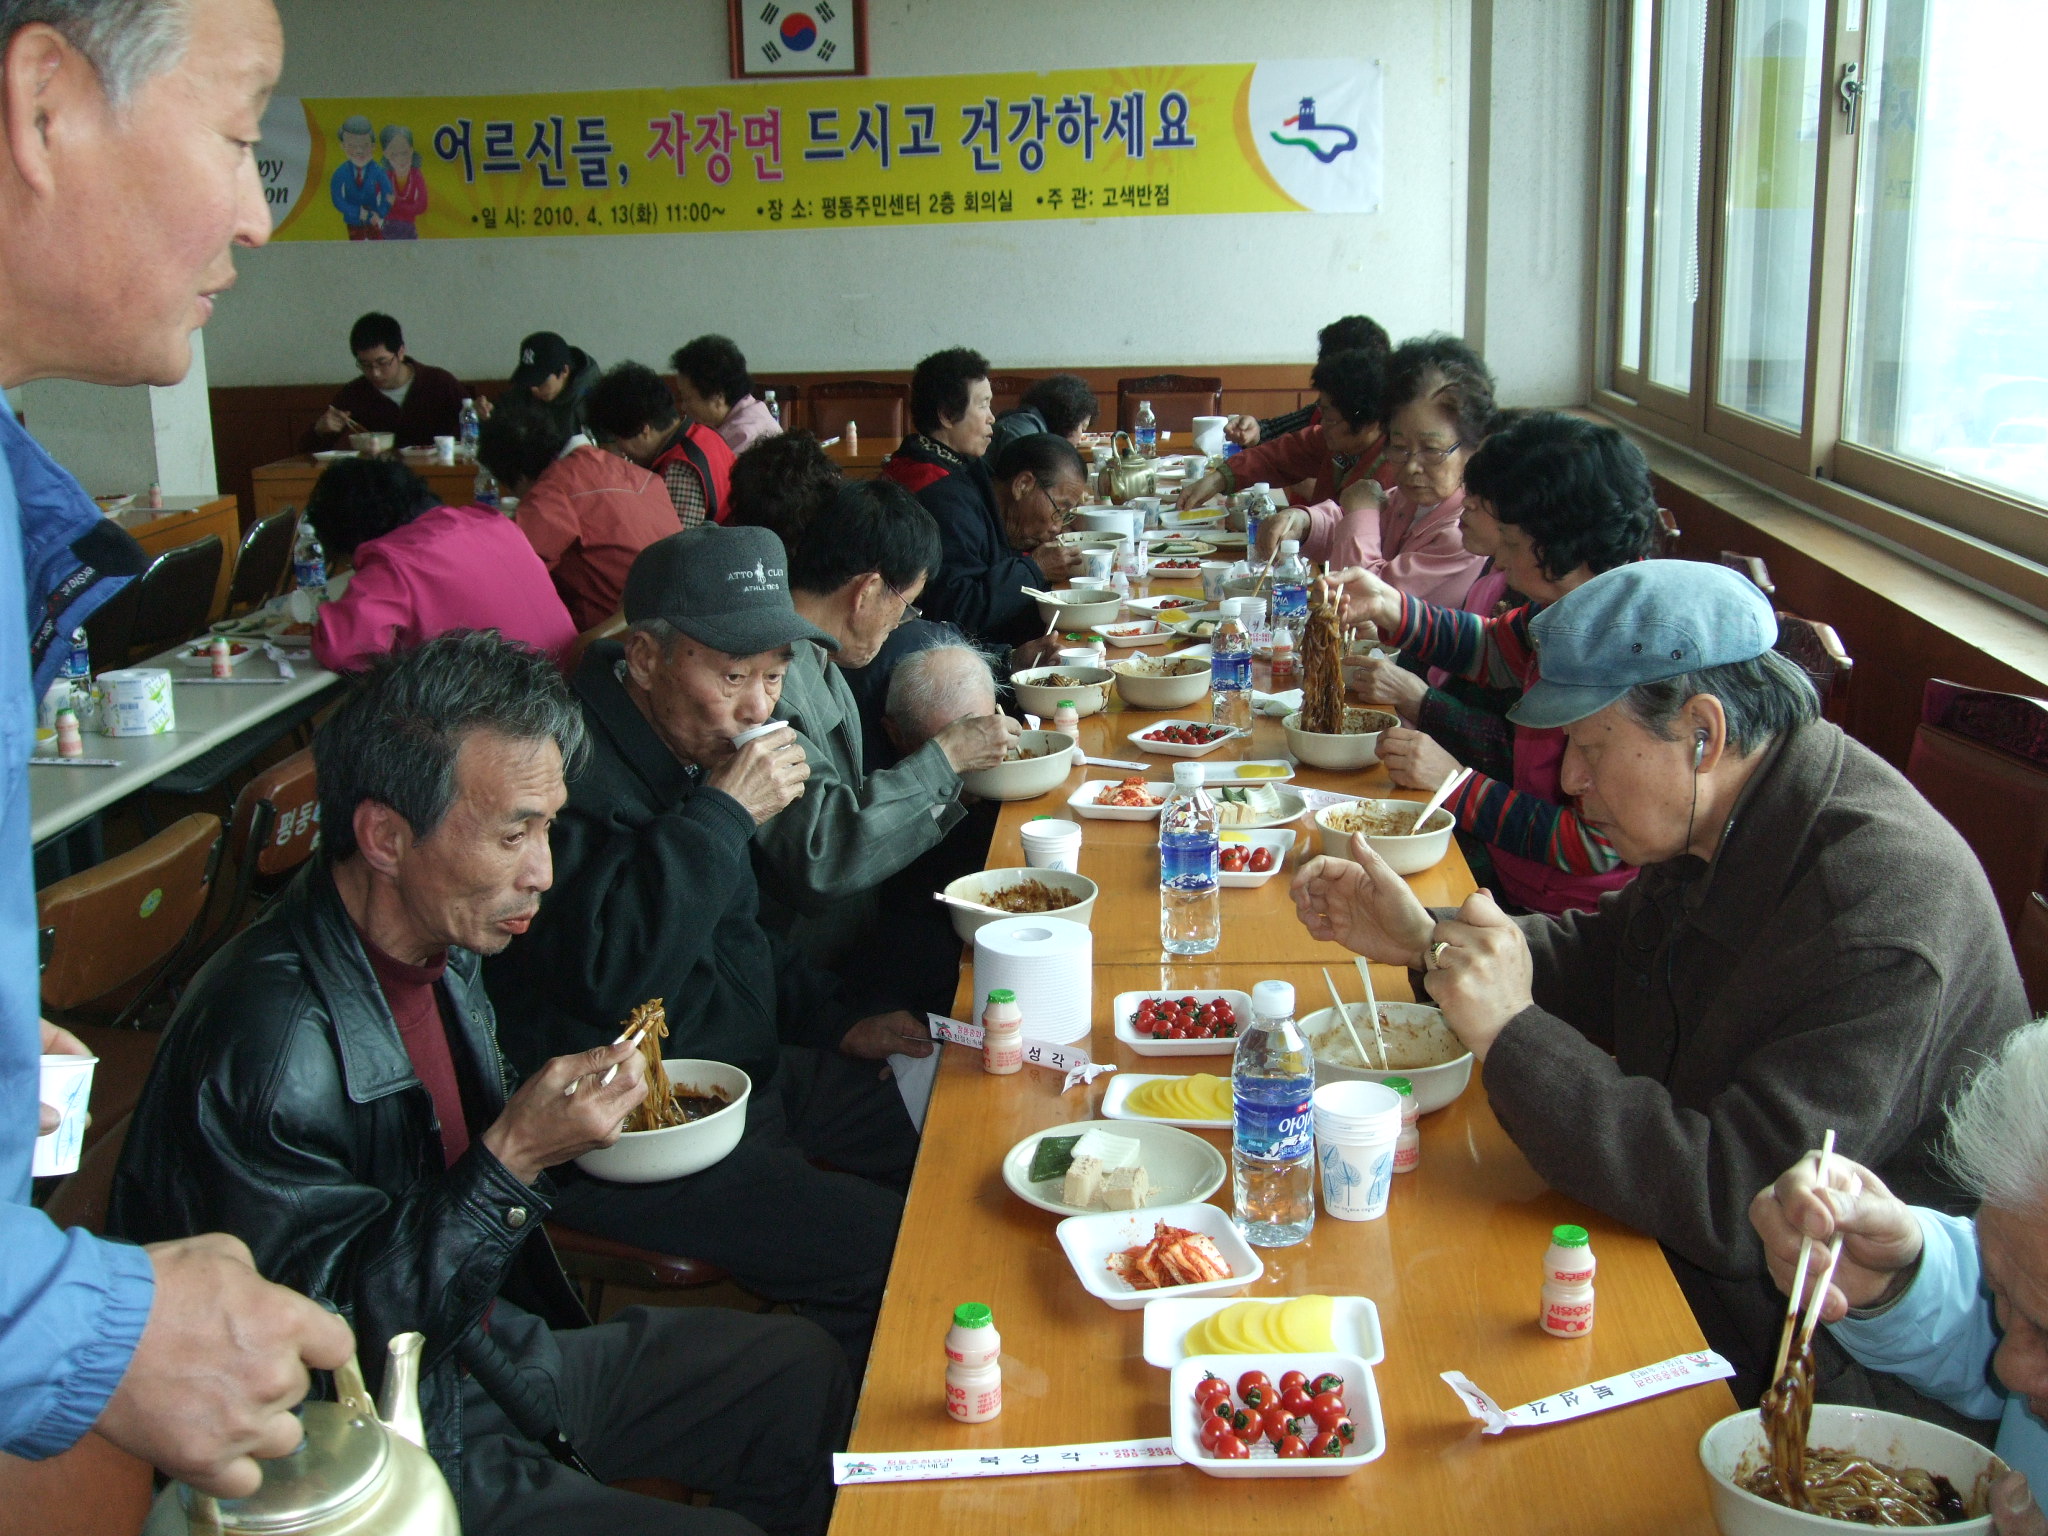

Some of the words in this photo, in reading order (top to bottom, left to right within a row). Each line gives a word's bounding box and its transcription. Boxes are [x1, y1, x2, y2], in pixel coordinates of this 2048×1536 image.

[433, 115, 629, 189] 어르신들,
[645, 107, 785, 185] 자장면
[803, 100, 941, 170] 드시고
[960, 88, 1196, 173] 건강하세요
[821, 193, 921, 218] 평동주민센터
[930, 192, 955, 215] 2층
[964, 190, 1013, 214] 회의실
[1102, 183, 1170, 208] 고색반점
[534, 206, 579, 227] 2010.
[587, 206, 602, 226] 4.
[611, 203, 658, 226] 13(화)
[666, 202, 726, 223] 11:00~
[728, 570, 753, 580] ATTO
[744, 583, 779, 592] ATHLETICS
[1555, 1269, 1592, 1281] 요구르트
[1549, 1304, 1591, 1317] 서울우유
